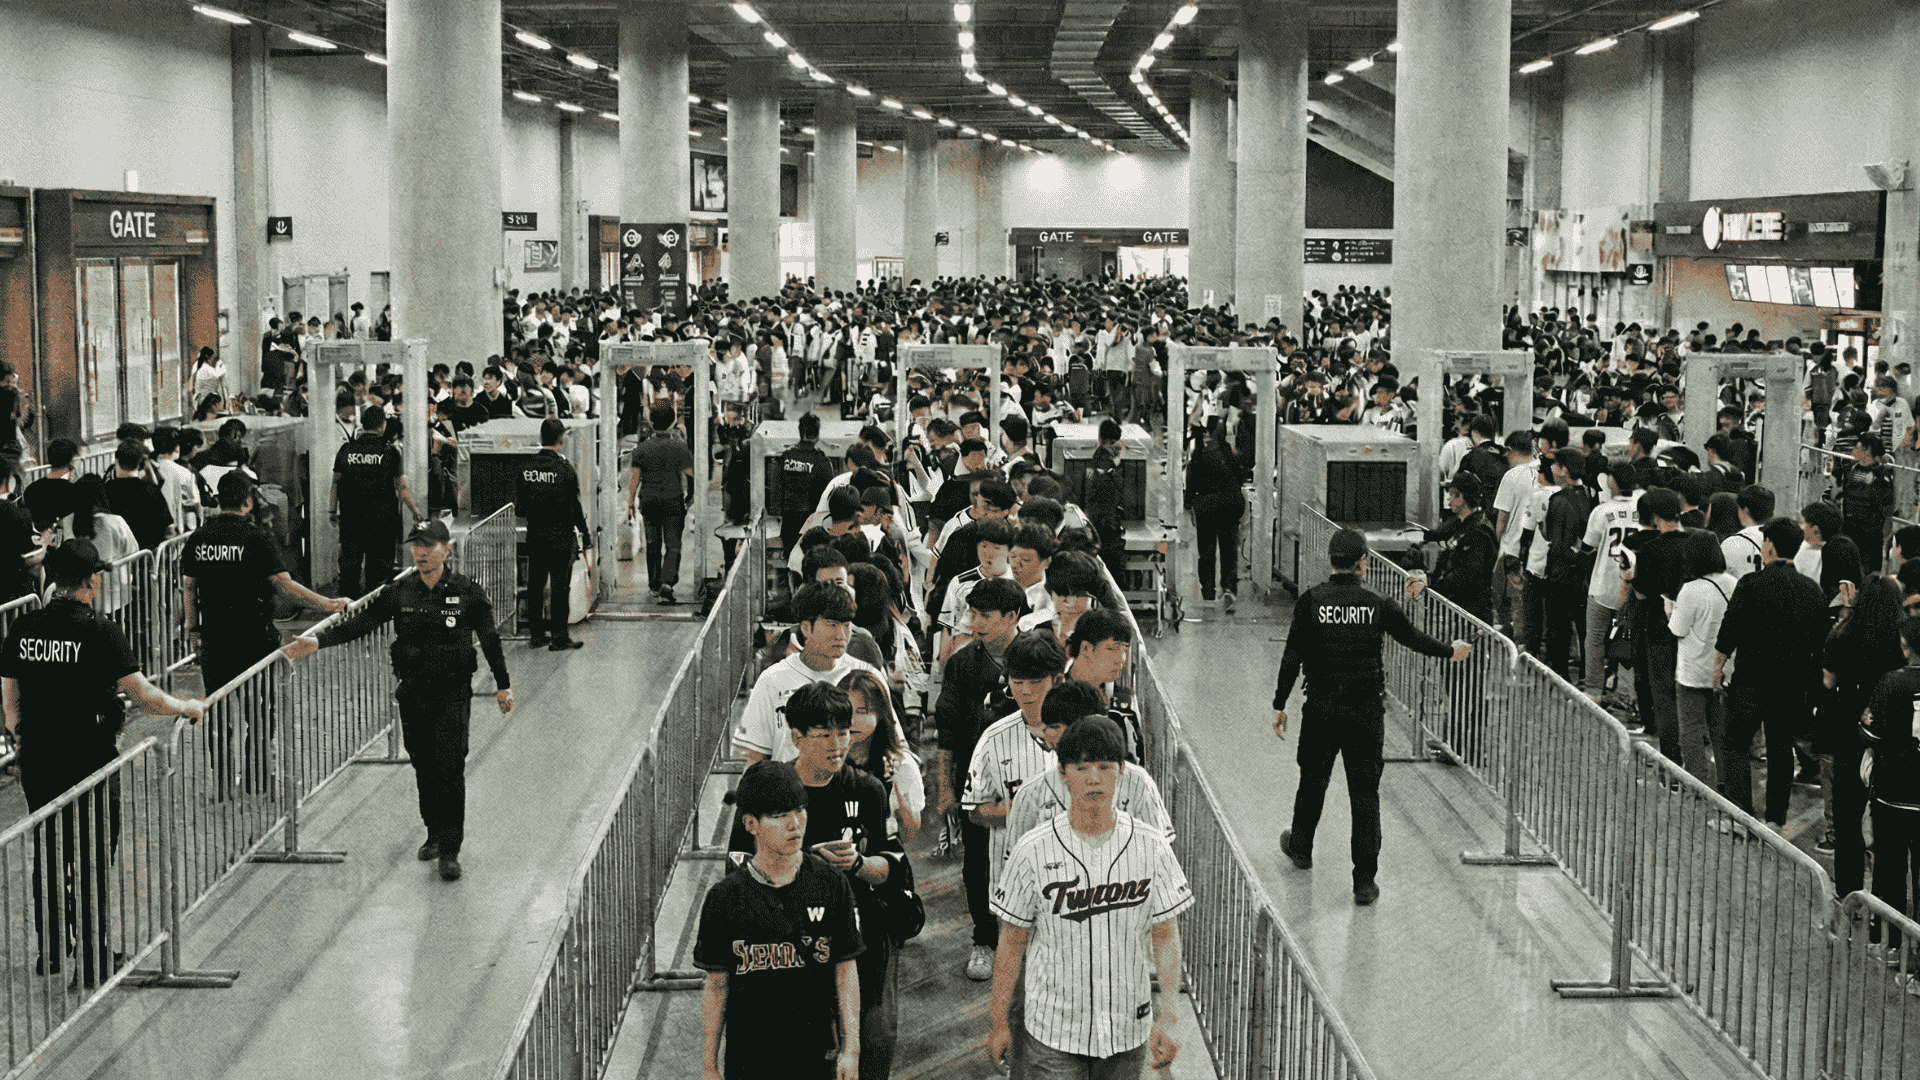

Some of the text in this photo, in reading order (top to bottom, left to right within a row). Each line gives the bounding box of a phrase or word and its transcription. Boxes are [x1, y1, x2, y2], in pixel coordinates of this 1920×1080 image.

[109, 210, 157, 239] GATE
[1039, 231, 1075, 243] GATE
[1143, 231, 1180, 243] GATE
[195, 544, 245, 562] SECURITY
[1318, 605, 1375, 625] SECURITY
[19, 637, 82, 663] SECURITY
[806, 906, 825, 922] W
